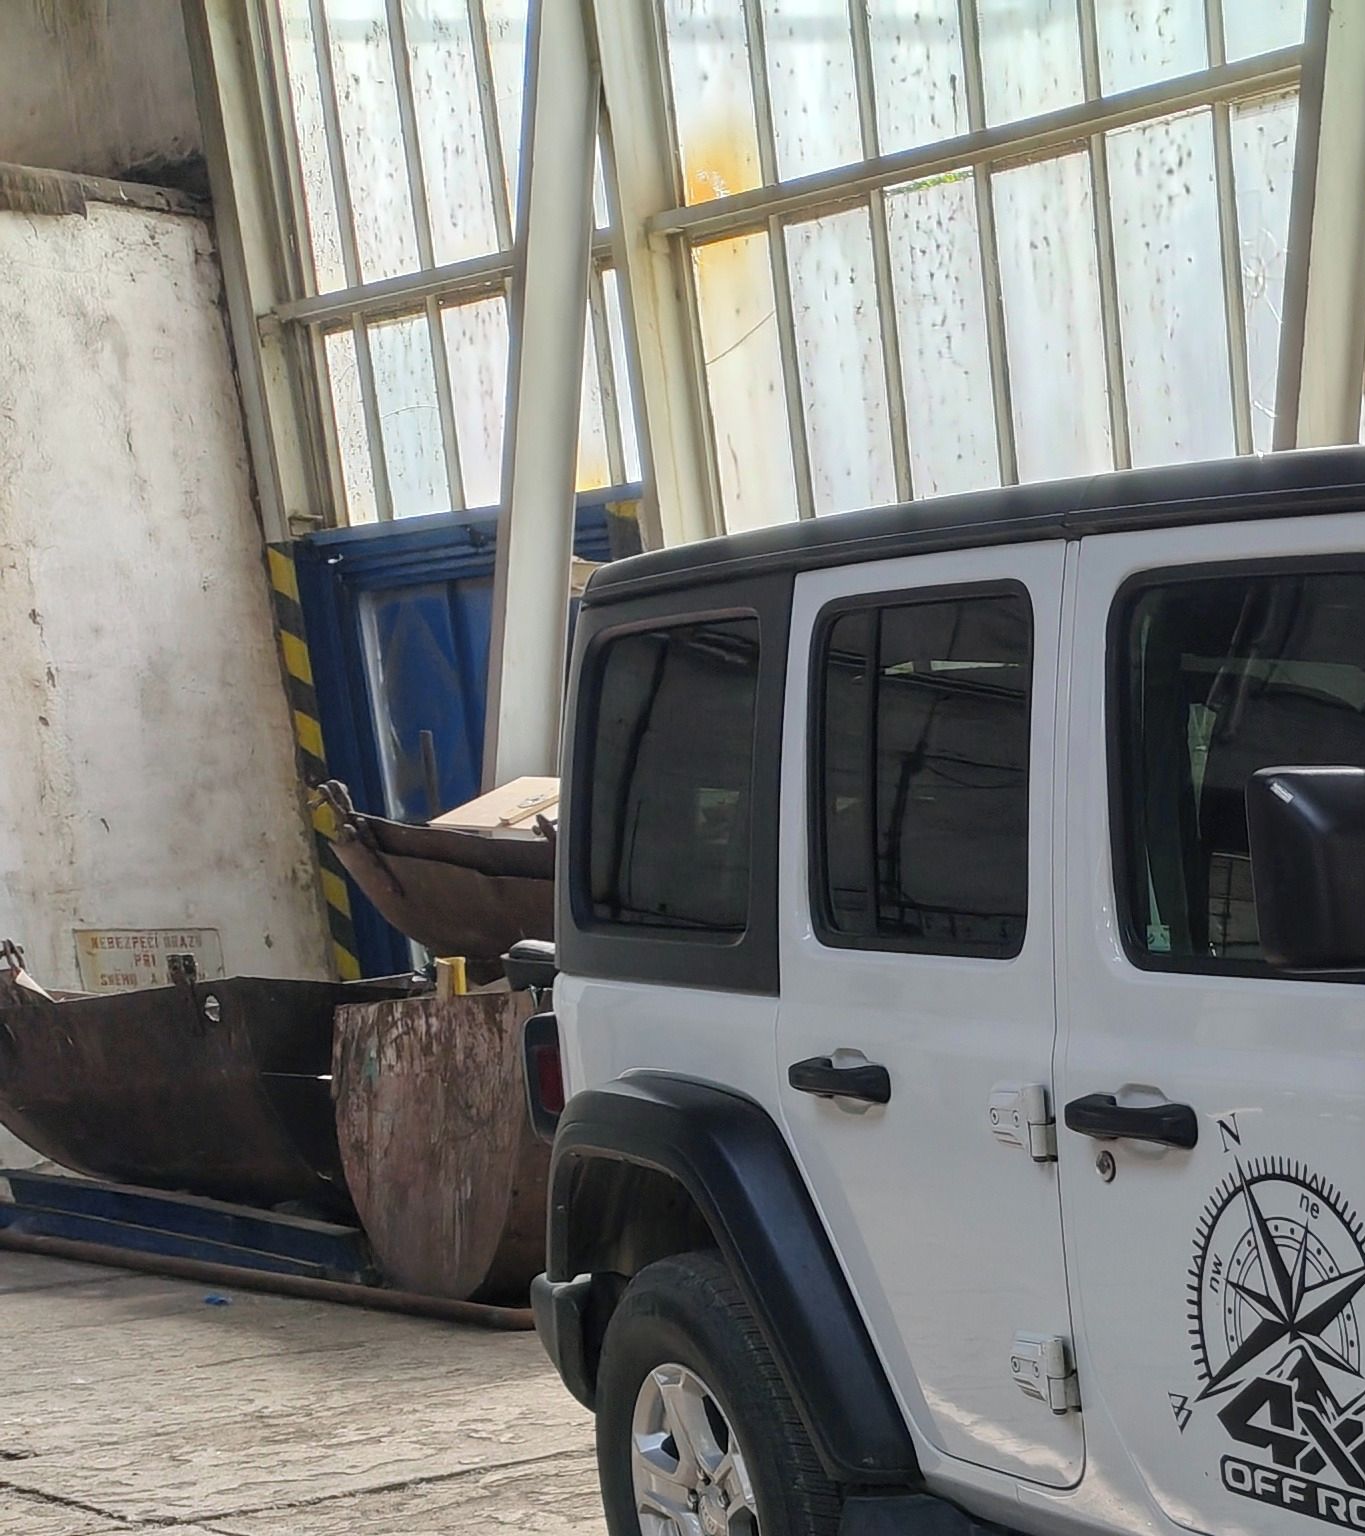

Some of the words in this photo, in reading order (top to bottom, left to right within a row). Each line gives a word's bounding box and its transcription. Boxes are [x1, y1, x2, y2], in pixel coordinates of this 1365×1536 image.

[1216, 1112, 1241, 1152] N
[1299, 1193, 1320, 1219] ne
[1224, 1461, 1308, 1505] OFF
